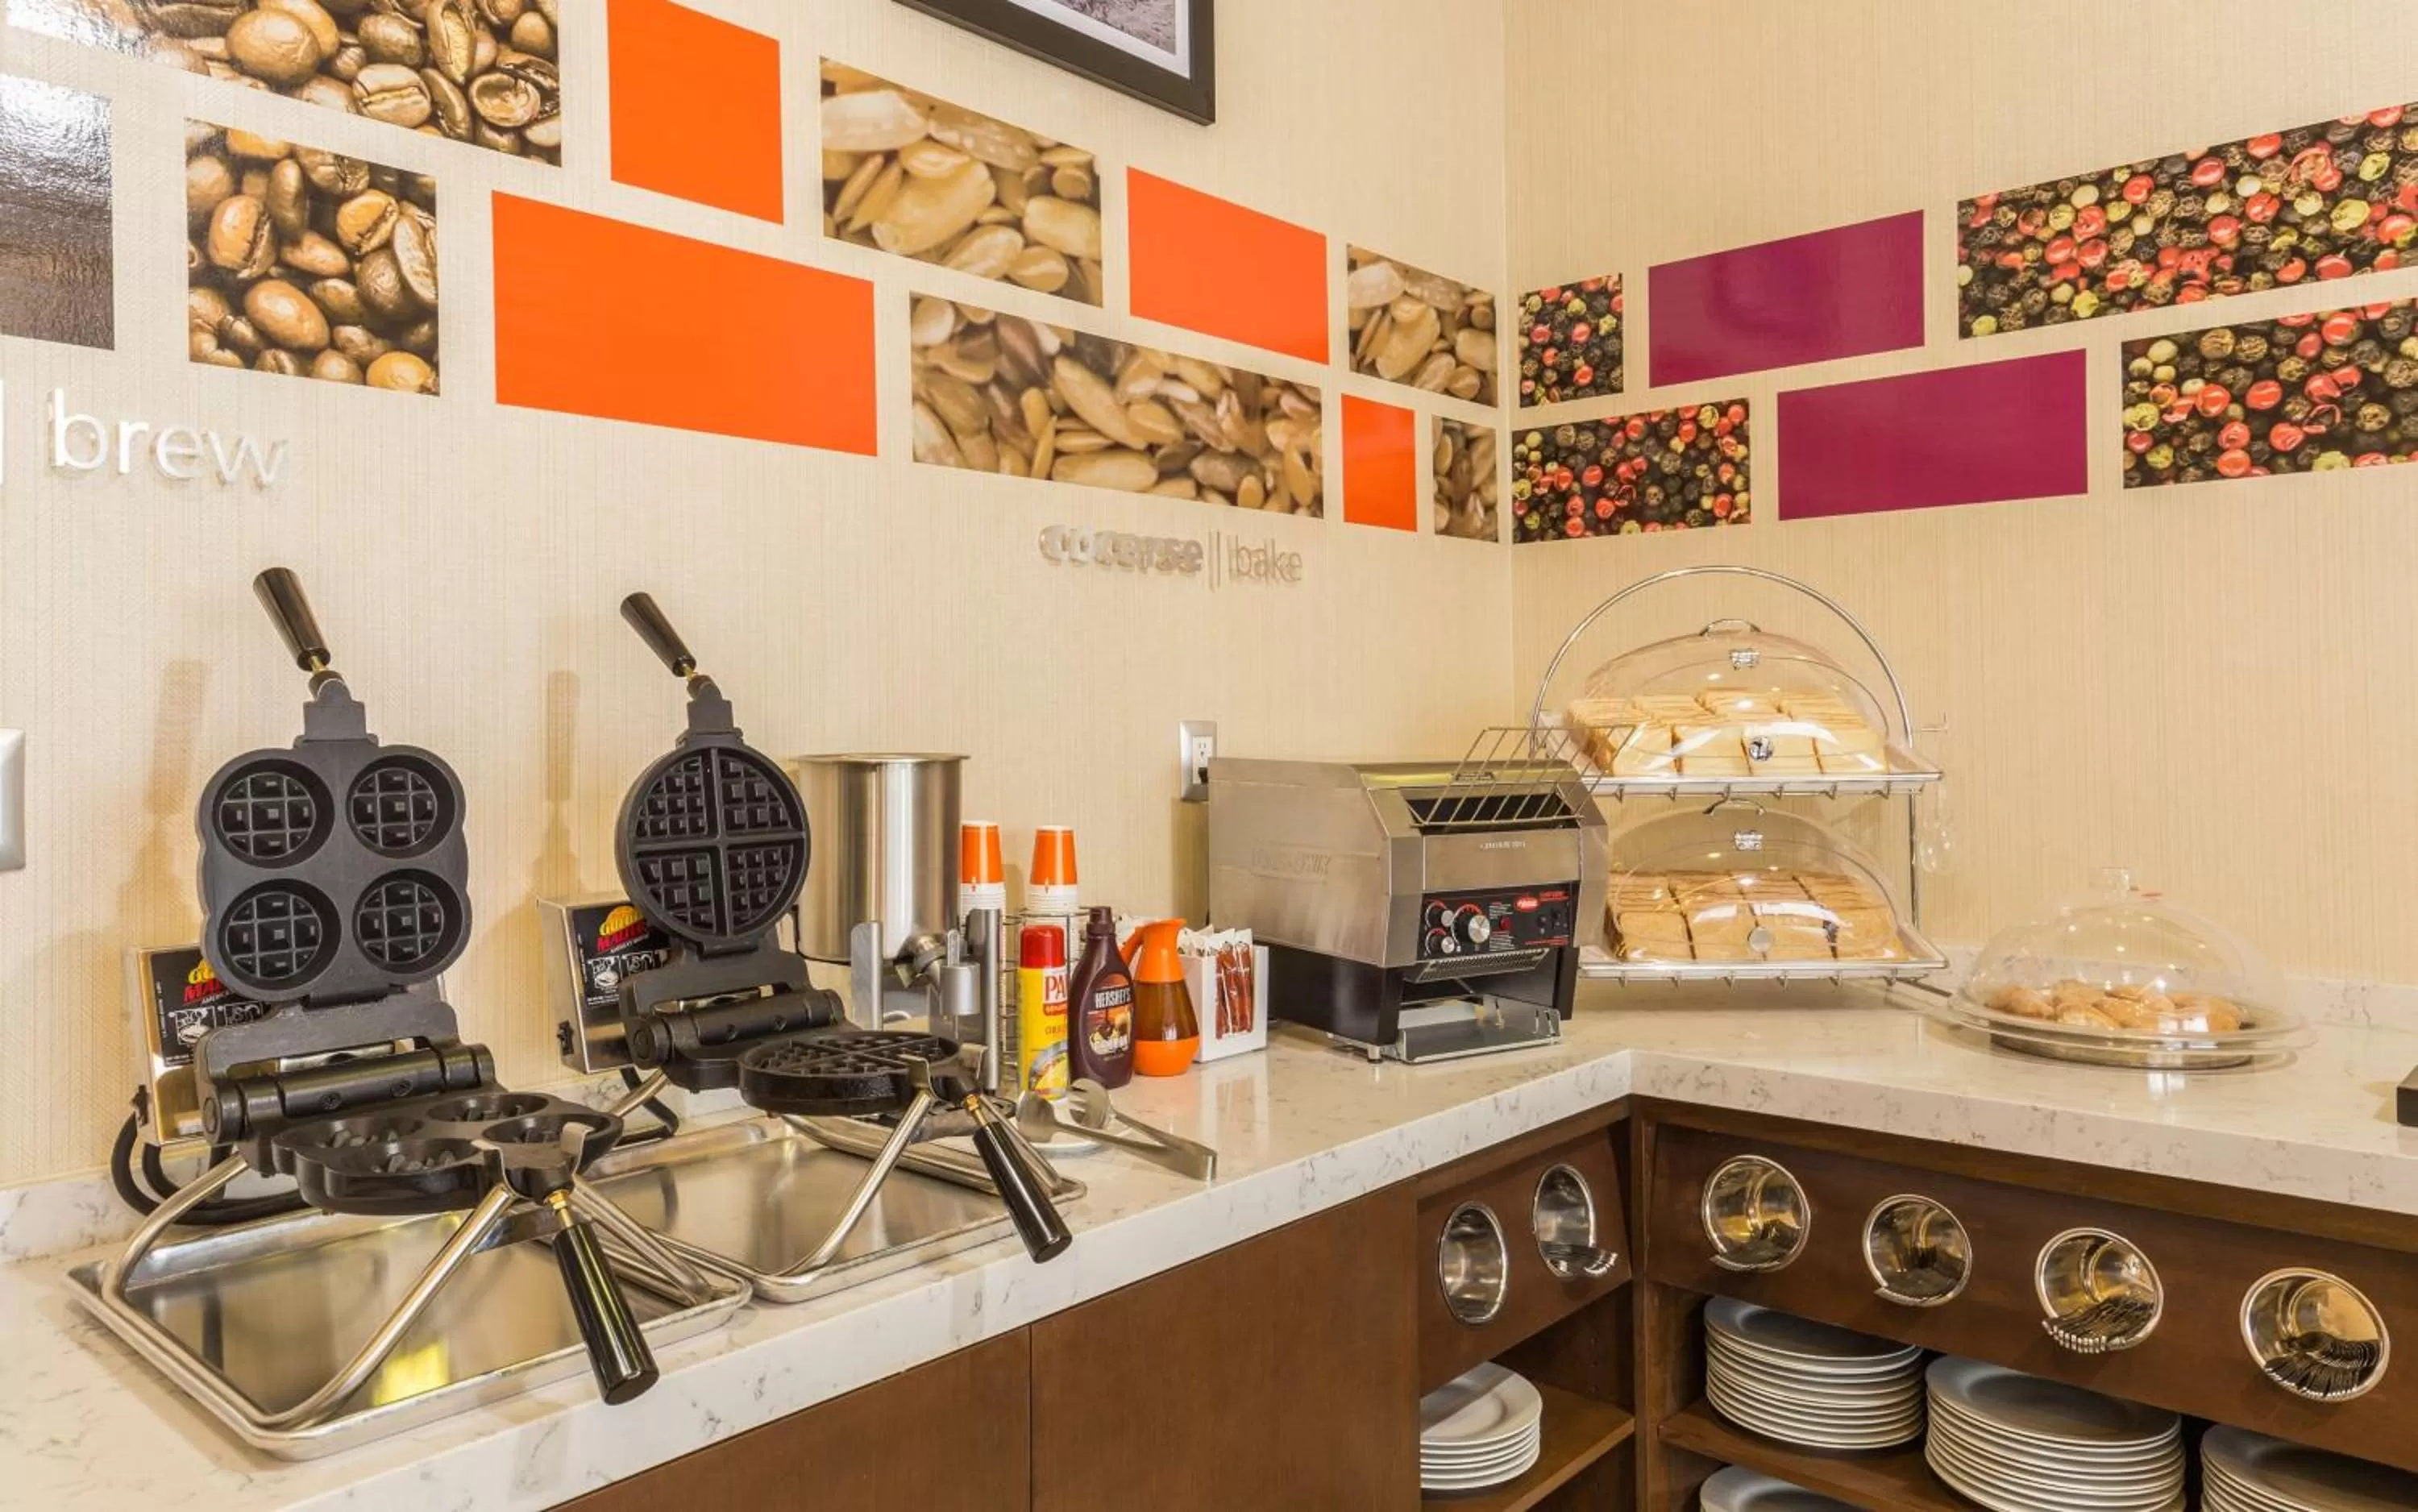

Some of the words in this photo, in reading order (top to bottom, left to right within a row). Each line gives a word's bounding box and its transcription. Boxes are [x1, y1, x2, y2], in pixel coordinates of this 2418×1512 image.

[48, 388, 288, 487] brew
[1229, 534, 1303, 584] bake
[1045, 974, 1068, 1001] PA
